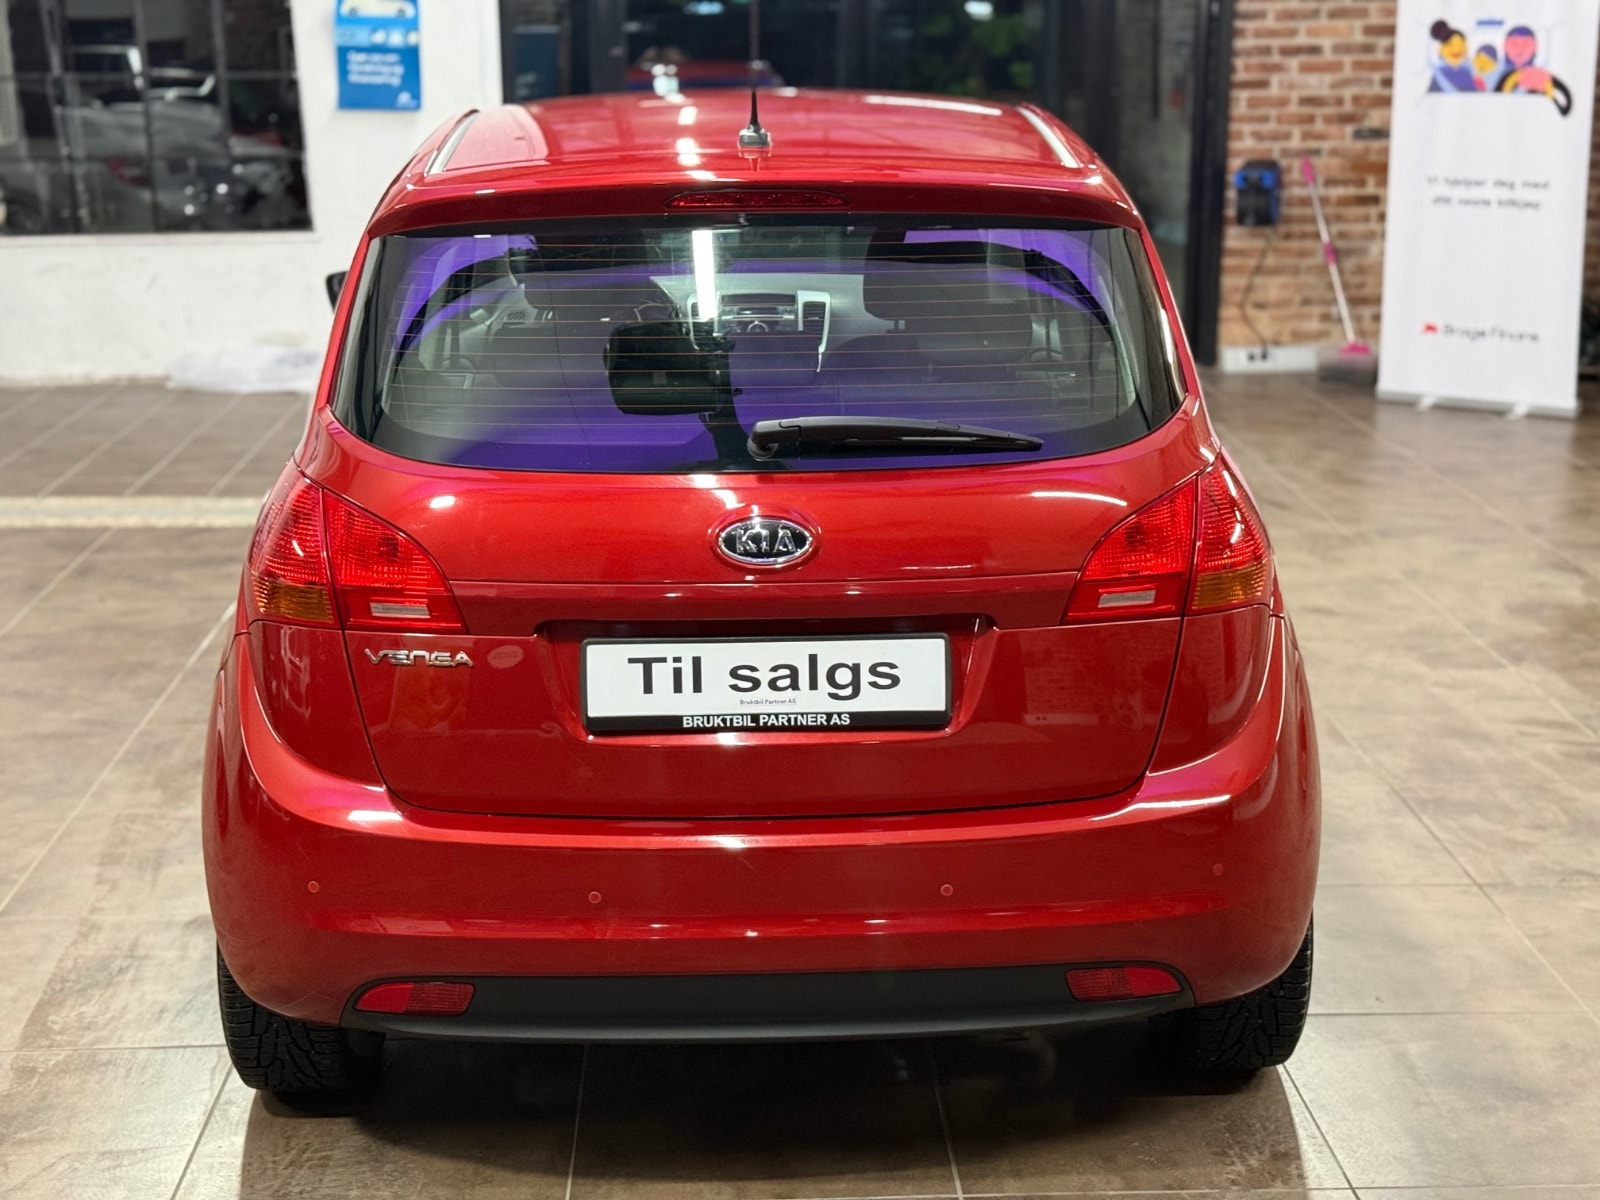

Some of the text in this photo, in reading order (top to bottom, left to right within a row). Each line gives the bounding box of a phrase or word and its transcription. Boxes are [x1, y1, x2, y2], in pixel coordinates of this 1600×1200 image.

[735, 527, 797, 553] KIA
[364, 647, 474, 667] VENGA
[626, 653, 901, 701] Til salgs
[682, 713, 851, 728] BRUKTBIL PARTNER AS
